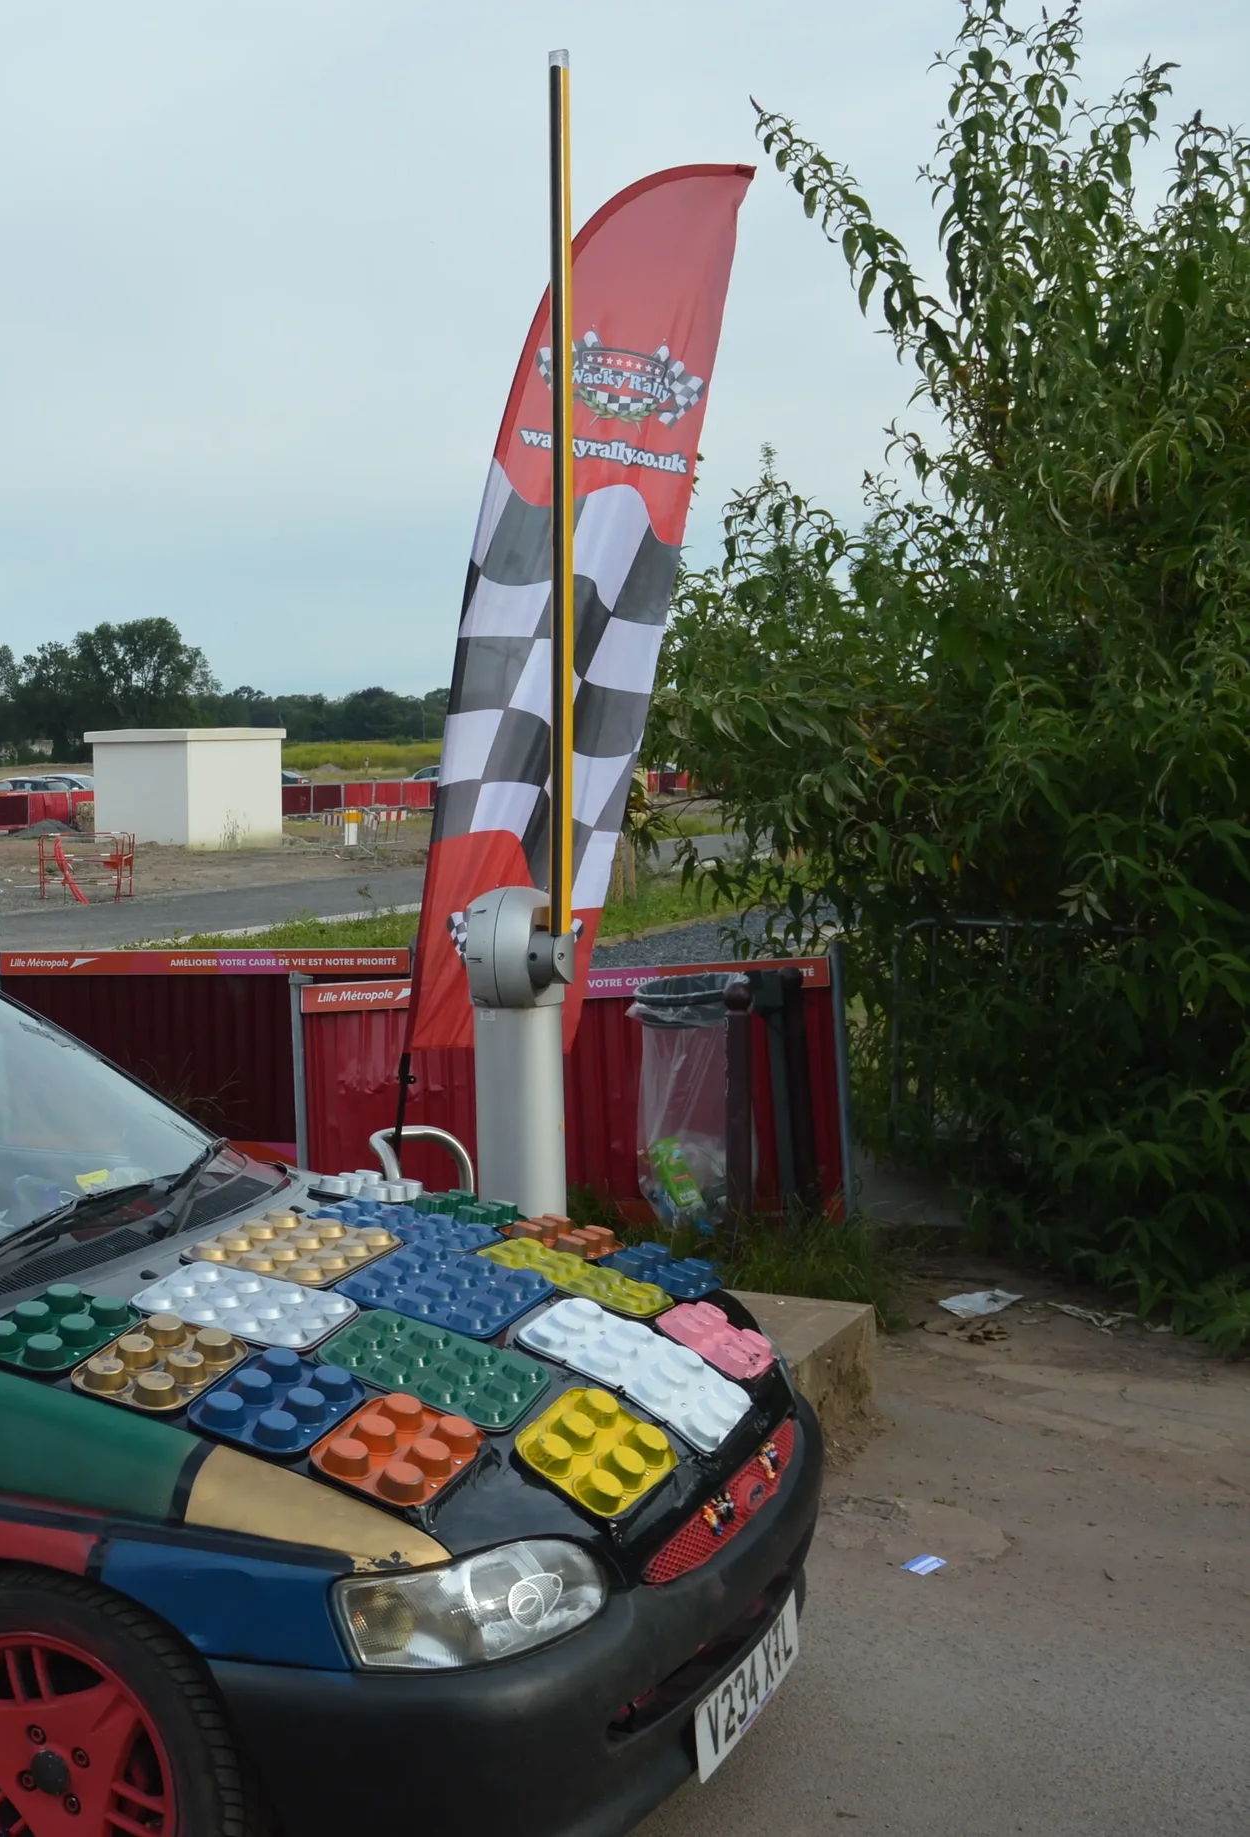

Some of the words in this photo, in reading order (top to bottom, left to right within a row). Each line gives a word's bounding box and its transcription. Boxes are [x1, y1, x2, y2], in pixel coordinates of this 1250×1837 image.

[628, 374, 672, 403] Rally
[519, 429, 687, 473] wayrally.co.uk
[10, 958, 26, 967] Lille
[27, 957, 69, 969] Métropole
[170, 956, 217, 967] AMÉLIORER
[219, 958, 247, 967] VOTRE
[248, 957, 277, 967] CADRE
[278, 957, 290, 966] DE
[292, 957, 306, 966] VIE
[308, 957, 323, 966] EST
[325, 957, 355, 966] NOTRE
[356, 955, 397, 966] PRIORITÉ
[587, 978, 622, 988] VOTRE
[317, 992, 338, 1003] Lille
[339, 989, 393, 1003] Métropole
[706, 1653, 760, 1756] V234
[761, 1613, 793, 1692] XTL
